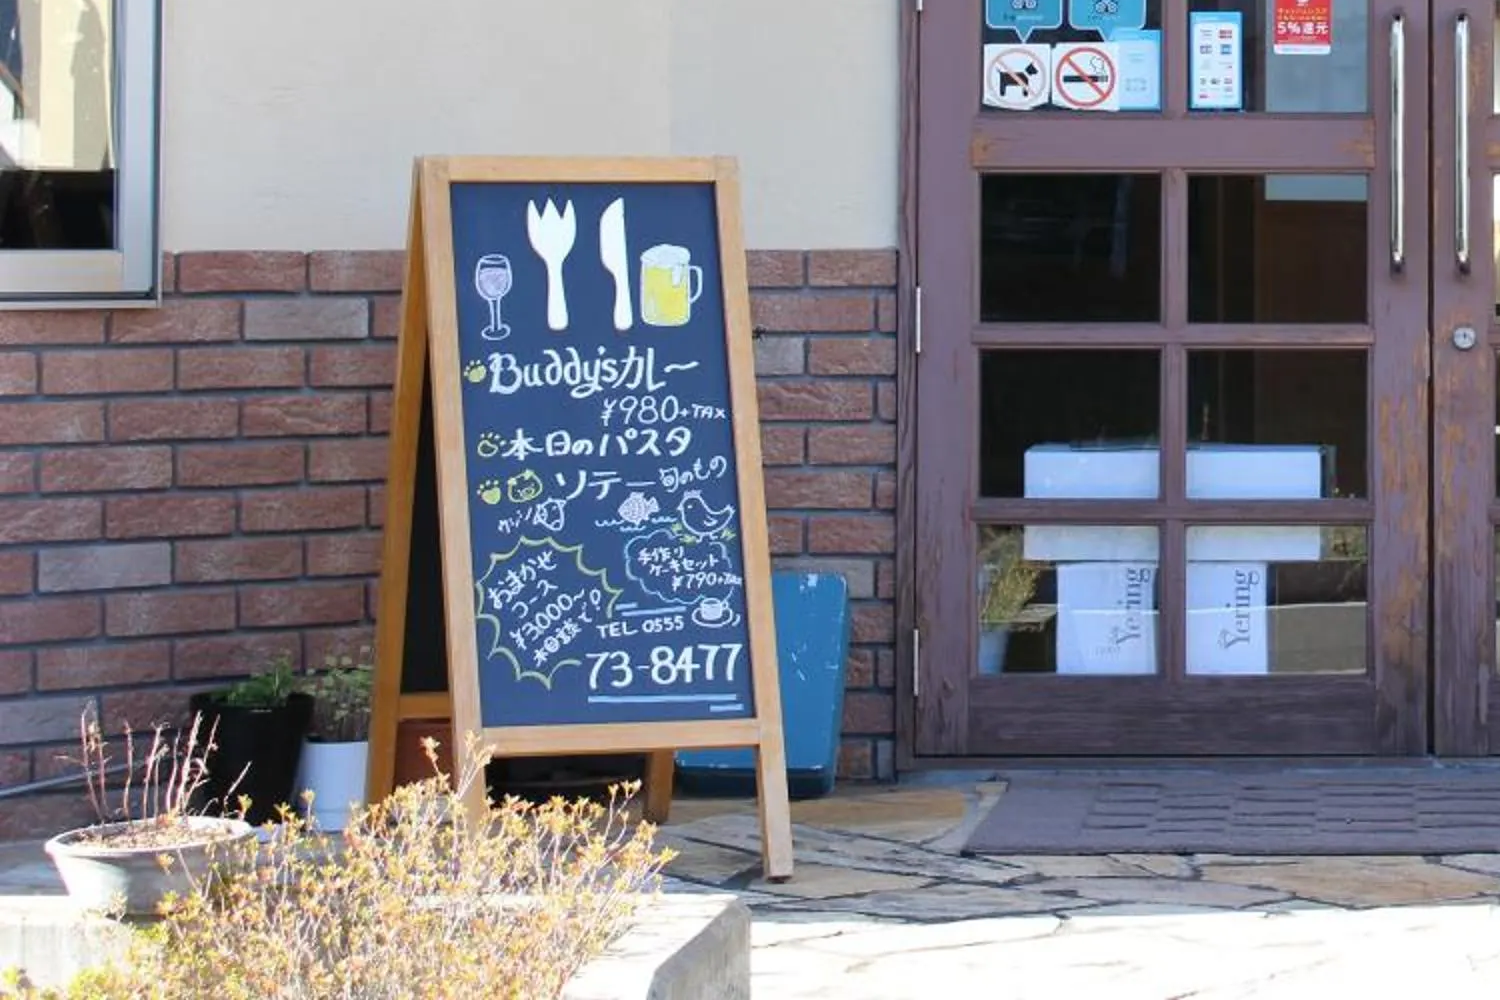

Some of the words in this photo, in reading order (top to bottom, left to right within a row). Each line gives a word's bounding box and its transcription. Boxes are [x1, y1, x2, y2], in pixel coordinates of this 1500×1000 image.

[502, 426, 692, 461] 本日のパスタ
[555, 469, 656, 500] ソテー
[637, 546, 685, 566] 手作り
[649, 554, 720, 577] ケーキセット
[487, 550, 558, 610] おまかせ
[510, 579, 560, 619] コース
[1222, 569, 1260, 650] Yering
[596, 621, 639, 640] TEL
[641, 615, 686, 634] 0555
[585, 643, 744, 691] 73-8477
